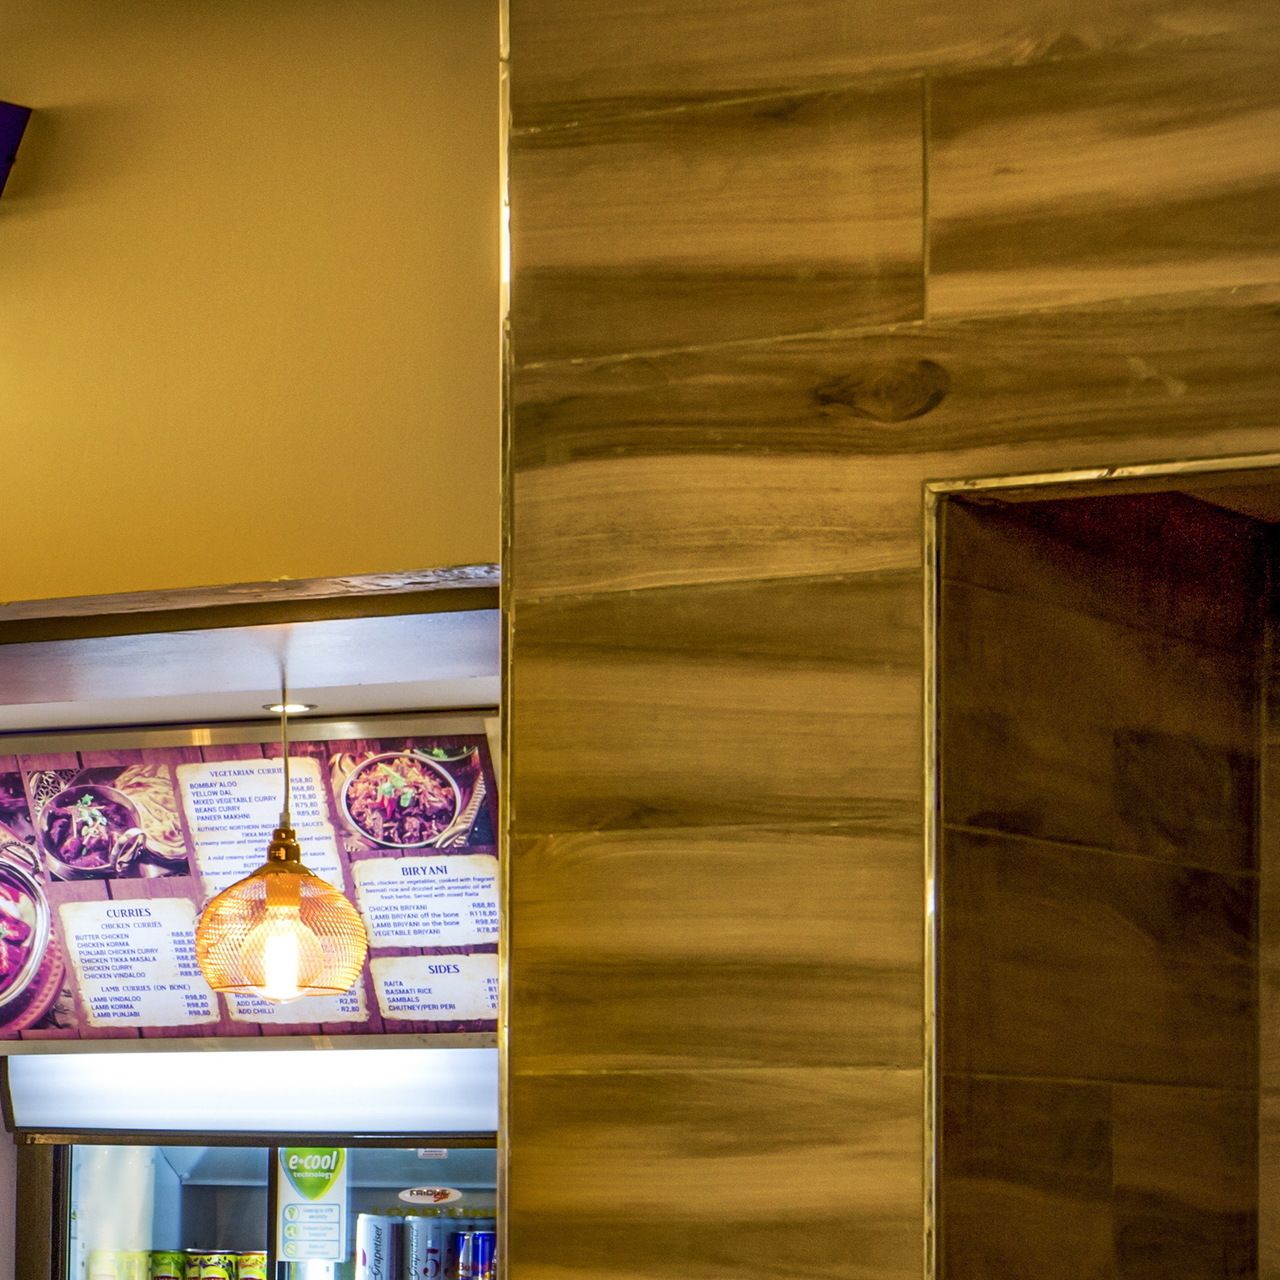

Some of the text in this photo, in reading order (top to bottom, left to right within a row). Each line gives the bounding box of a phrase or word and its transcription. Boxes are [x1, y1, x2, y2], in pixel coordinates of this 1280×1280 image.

[210, 770, 255, 778] VEGETARIAN
[401, 866, 447, 876] BIRYANI
[107, 908, 151, 918] CURRIES
[101, 922, 131, 930] CHICKEN
[428, 965, 460, 974] SIDES
[293, 1171, 333, 1180] technology
[423, 1248, 440, 1278] 5
